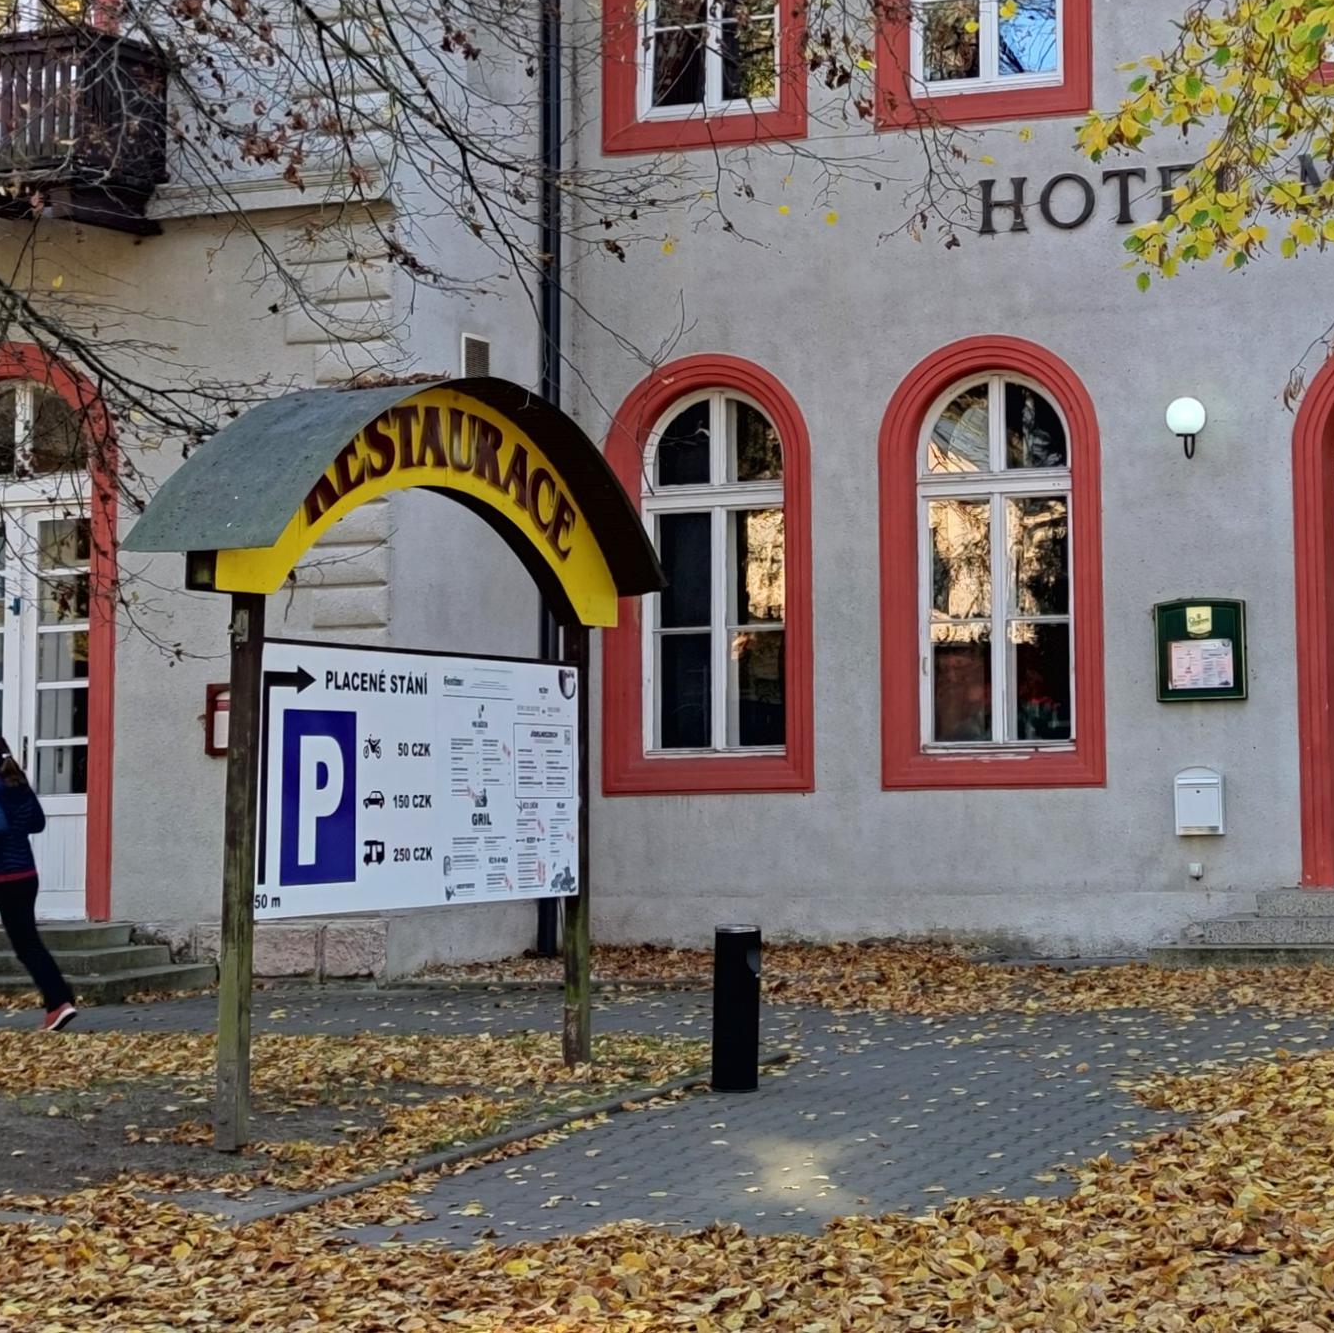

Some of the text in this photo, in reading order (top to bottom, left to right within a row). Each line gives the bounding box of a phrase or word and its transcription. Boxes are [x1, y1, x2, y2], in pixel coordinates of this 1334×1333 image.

[325, 669, 386, 693] PLACENÉ
[390, 670, 428, 695] STÁNÍ
[397, 742, 431, 757] 50 CZK
[297, 735, 344, 866] P
[393, 794, 432, 809] 150 CZK
[471, 812, 492, 826] GRIL
[393, 847, 433, 862] 250 CZK
[255, 894, 281, 909] 50 m
